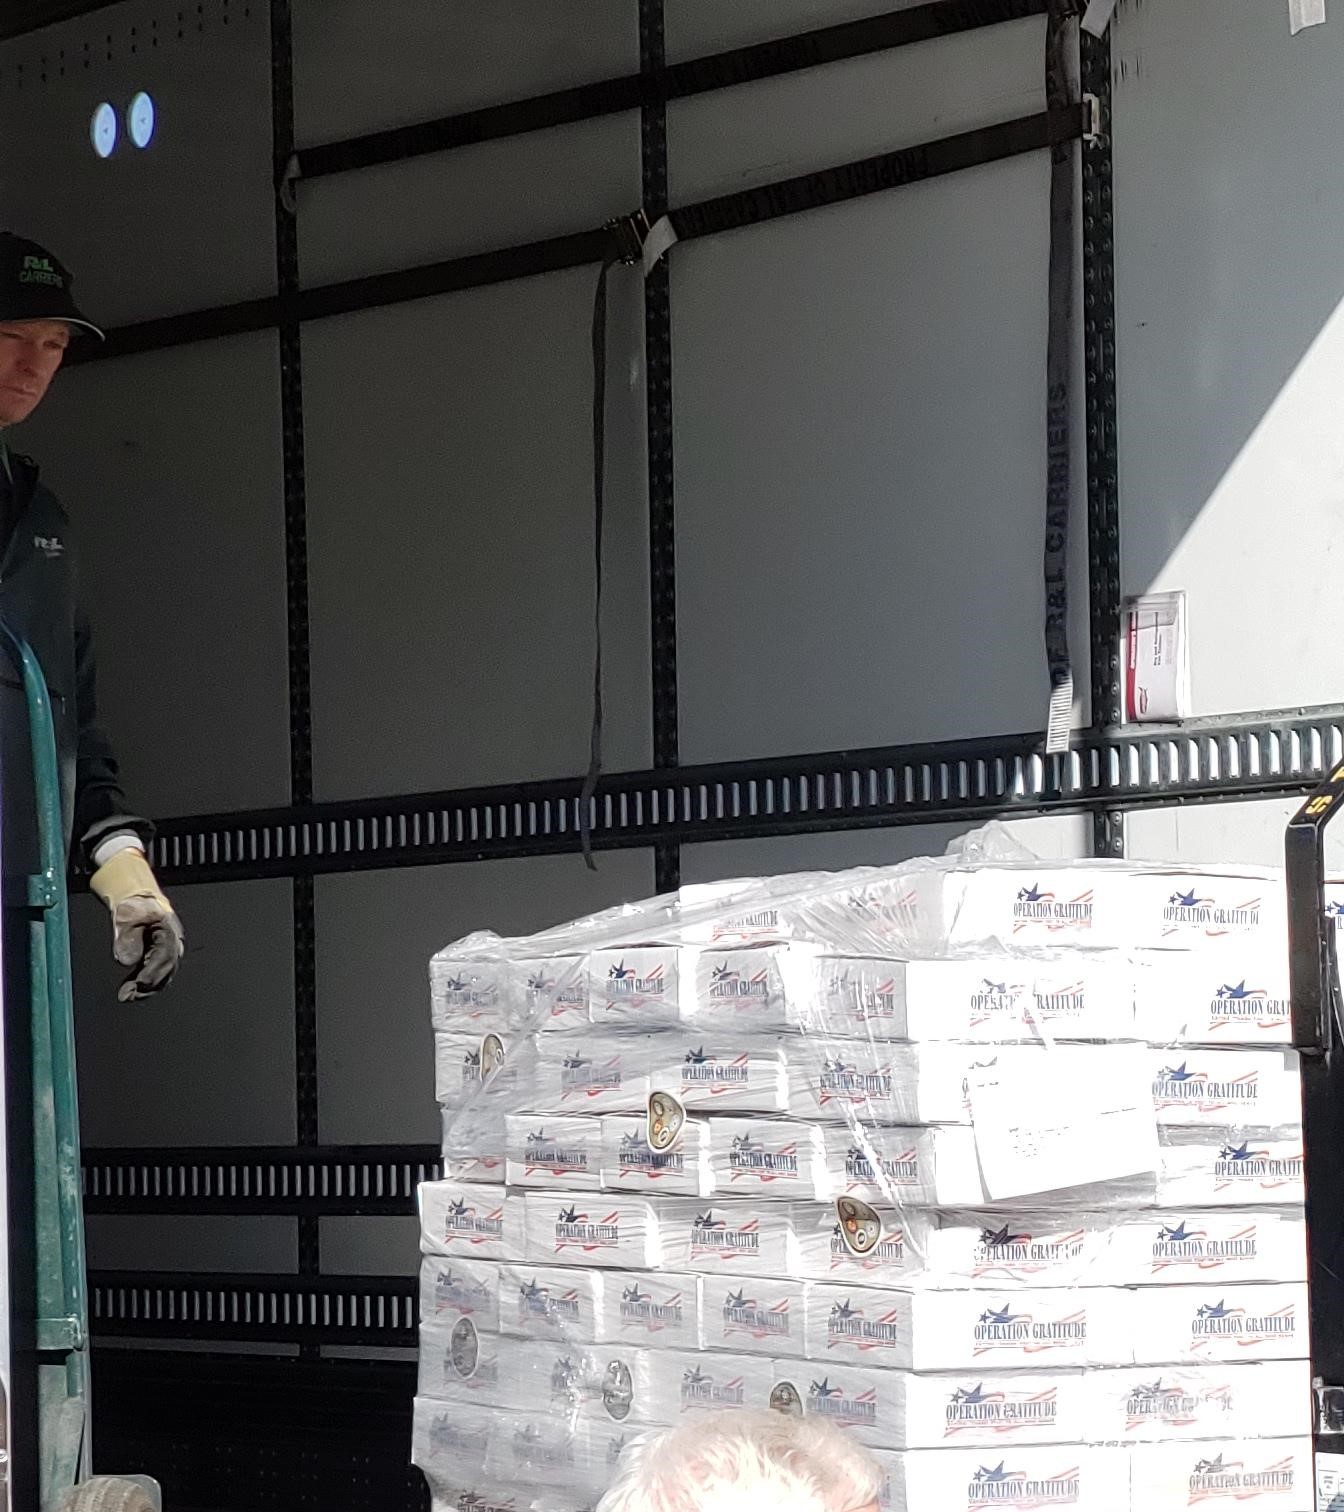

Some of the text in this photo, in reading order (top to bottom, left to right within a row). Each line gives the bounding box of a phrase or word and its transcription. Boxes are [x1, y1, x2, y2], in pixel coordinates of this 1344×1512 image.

[1211, 999, 1264, 1016] OPERATION
[1152, 1081, 1259, 1099] OPERATION GRATITUDE
[1215, 1158, 1302, 1177] OPERATION GRATIT
[1152, 1239, 1258, 1258] OPERATION GRATITUDE
[974, 1320, 1087, 1341] OPERATION GRATITUDE
[1191, 1315, 1297, 1335] OPERATION GRATITUDE
[946, 1400, 1058, 1421] OPERATION GRATITUDE
[968, 1478, 1080, 1500] OPERATION GRATITUDE
[1188, 1469, 1295, 1491] OPERATION GRATITUDE
